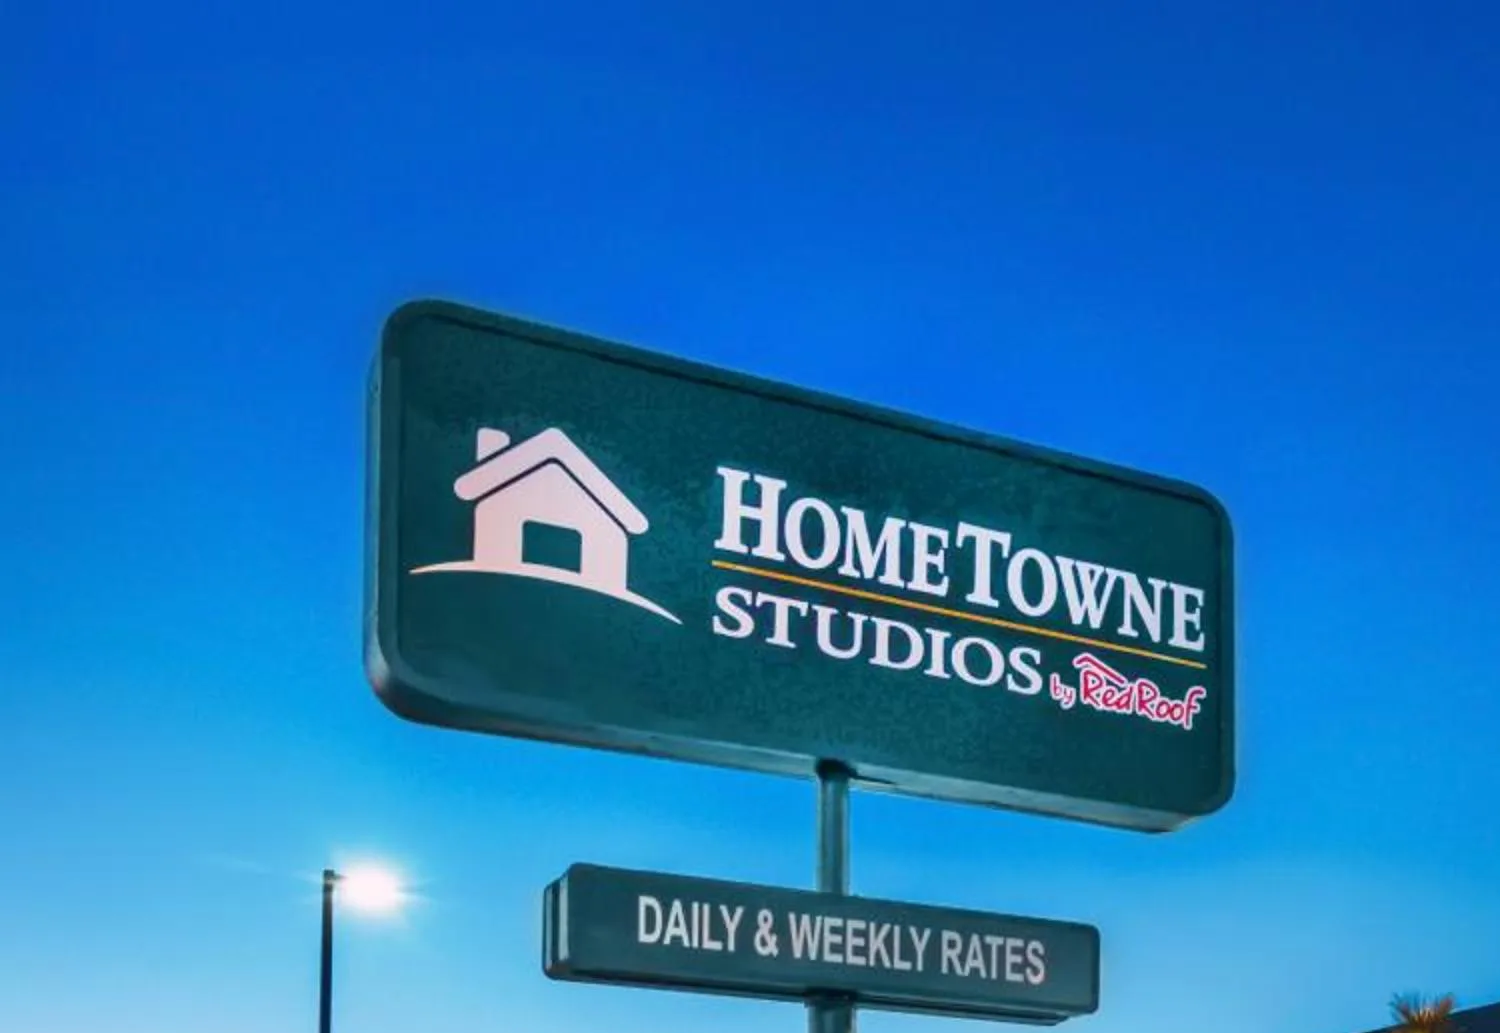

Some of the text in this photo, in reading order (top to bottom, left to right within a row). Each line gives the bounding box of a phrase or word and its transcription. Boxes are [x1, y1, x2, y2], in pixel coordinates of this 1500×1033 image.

[712, 586, 1042, 694] STUDIOS
[1050, 673, 1076, 709] by
[638, 896, 1045, 985] DAILY & WEEKLY RATES
